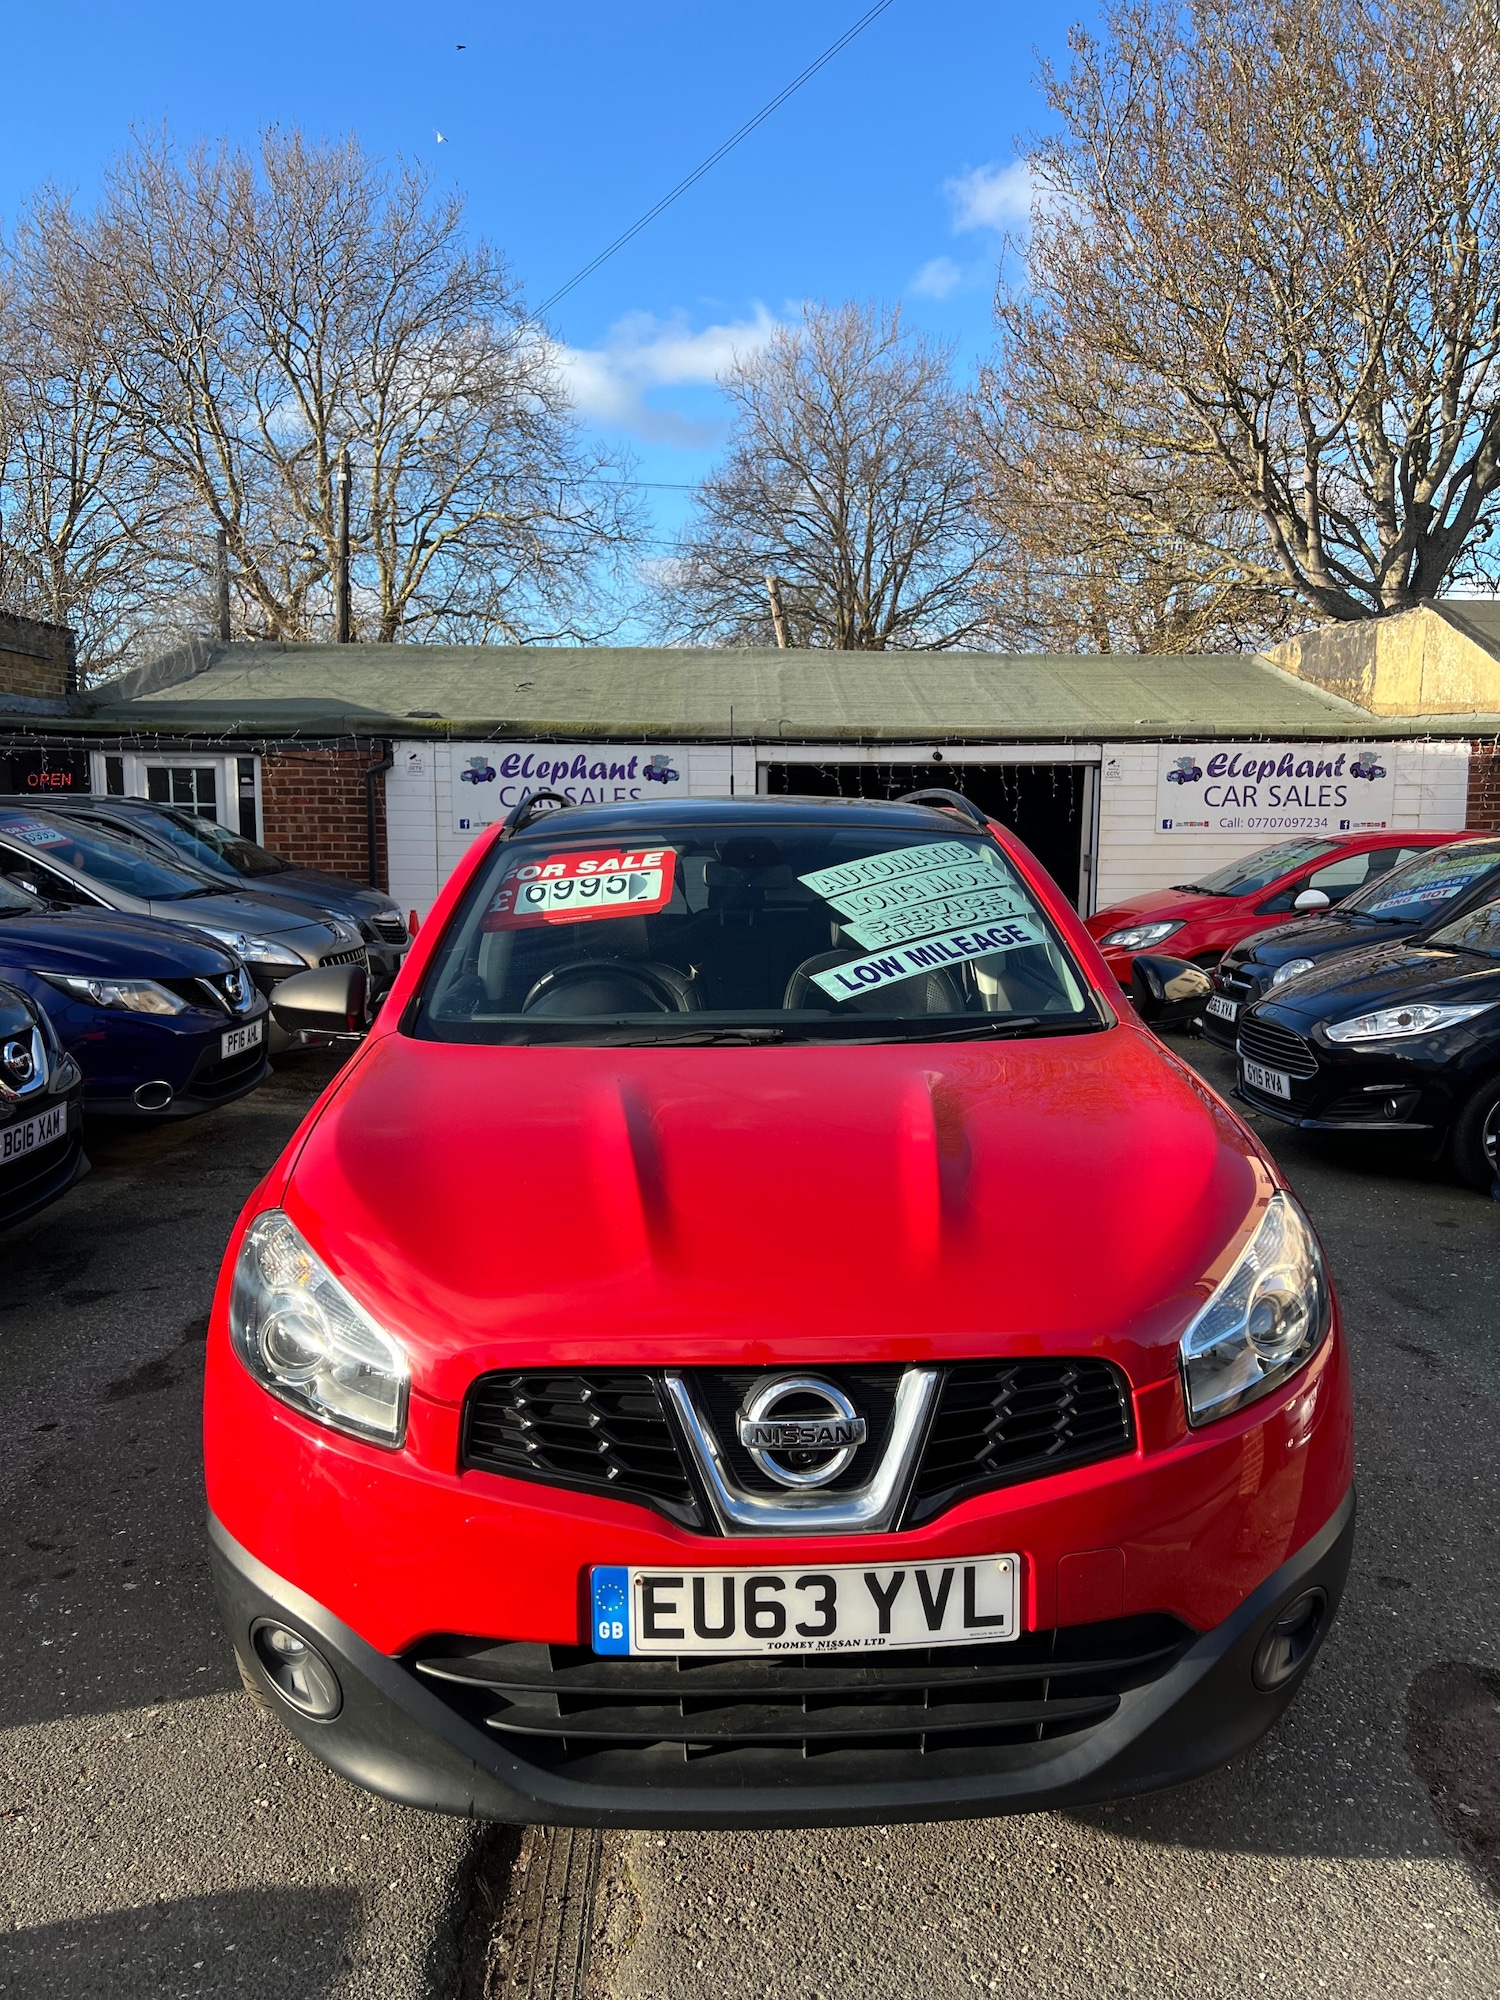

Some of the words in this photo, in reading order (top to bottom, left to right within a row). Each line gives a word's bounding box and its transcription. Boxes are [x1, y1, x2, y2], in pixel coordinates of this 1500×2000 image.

[27, 772, 72, 787] OPEN
[500, 753, 638, 785] Elephant
[1206, 753, 1346, 784] Elephant
[1204, 785, 1257, 807] CAR
[1268, 785, 1347, 807] SALES
[1219, 817, 1243, 828] Call:
[1247, 817, 1328, 828] 07707097234
[502, 864, 566, 885] FOR
[576, 852, 664, 874] SALE
[812, 844, 973, 893] AUTOMATIC
[525, 873, 628, 903] 6995
[836, 881, 923, 916] LONG
[1376, 896, 1413, 910] LONG
[1419, 888, 1452, 900] MOT
[1389, 889, 1415, 900] LOW
[1415, 876, 1471, 892] MILEAGE
[860, 891, 1010, 932] SERVICE
[870, 902, 1016, 943] HISTORY
[833, 957, 906, 991] LOW
[904, 924, 1033, 968] MILEAGE
[227, 1030, 245, 1053] PF16
[1247, 1063, 1263, 1086] GY15
[1264, 1071, 1283, 1094] RVA
[3, 1122, 34, 1158] BG16
[38, 1109, 60, 1142] XAM
[754, 1424, 854, 1444] NISSAN
[642, 1574, 837, 1641] EU63
[864, 1565, 1005, 1635] YVL
[598, 1621, 624, 1640] GB
[767, 1641, 815, 1650] TOOMEY
[817, 1639, 862, 1649] NISSAN
[864, 1638, 886, 1646] LTD
